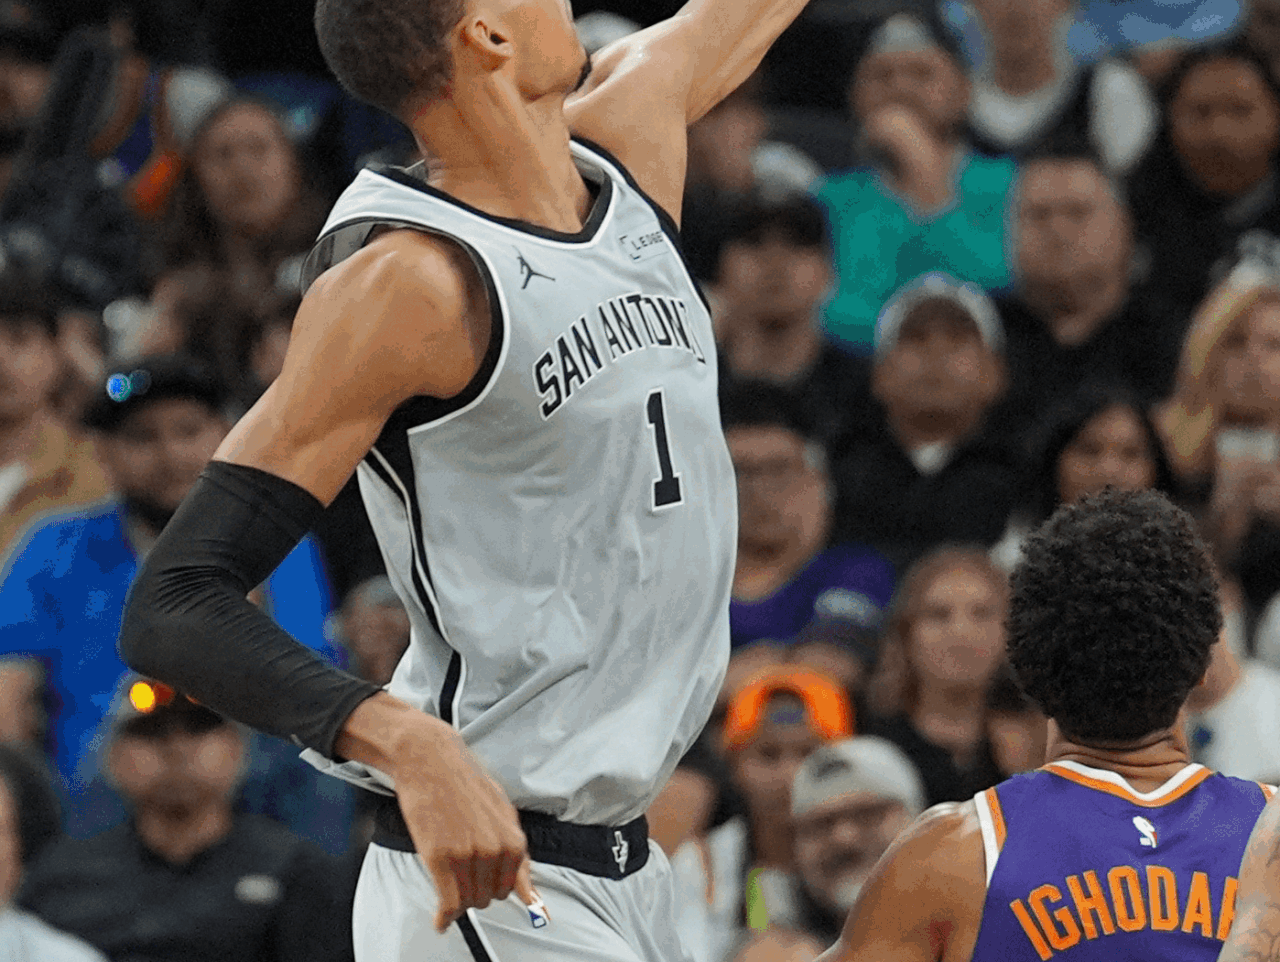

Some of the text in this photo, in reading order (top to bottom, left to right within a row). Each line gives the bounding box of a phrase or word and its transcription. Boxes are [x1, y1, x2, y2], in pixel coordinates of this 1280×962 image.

[532, 292, 708, 421] SAN ANTON
[645, 387, 684, 512] 1
